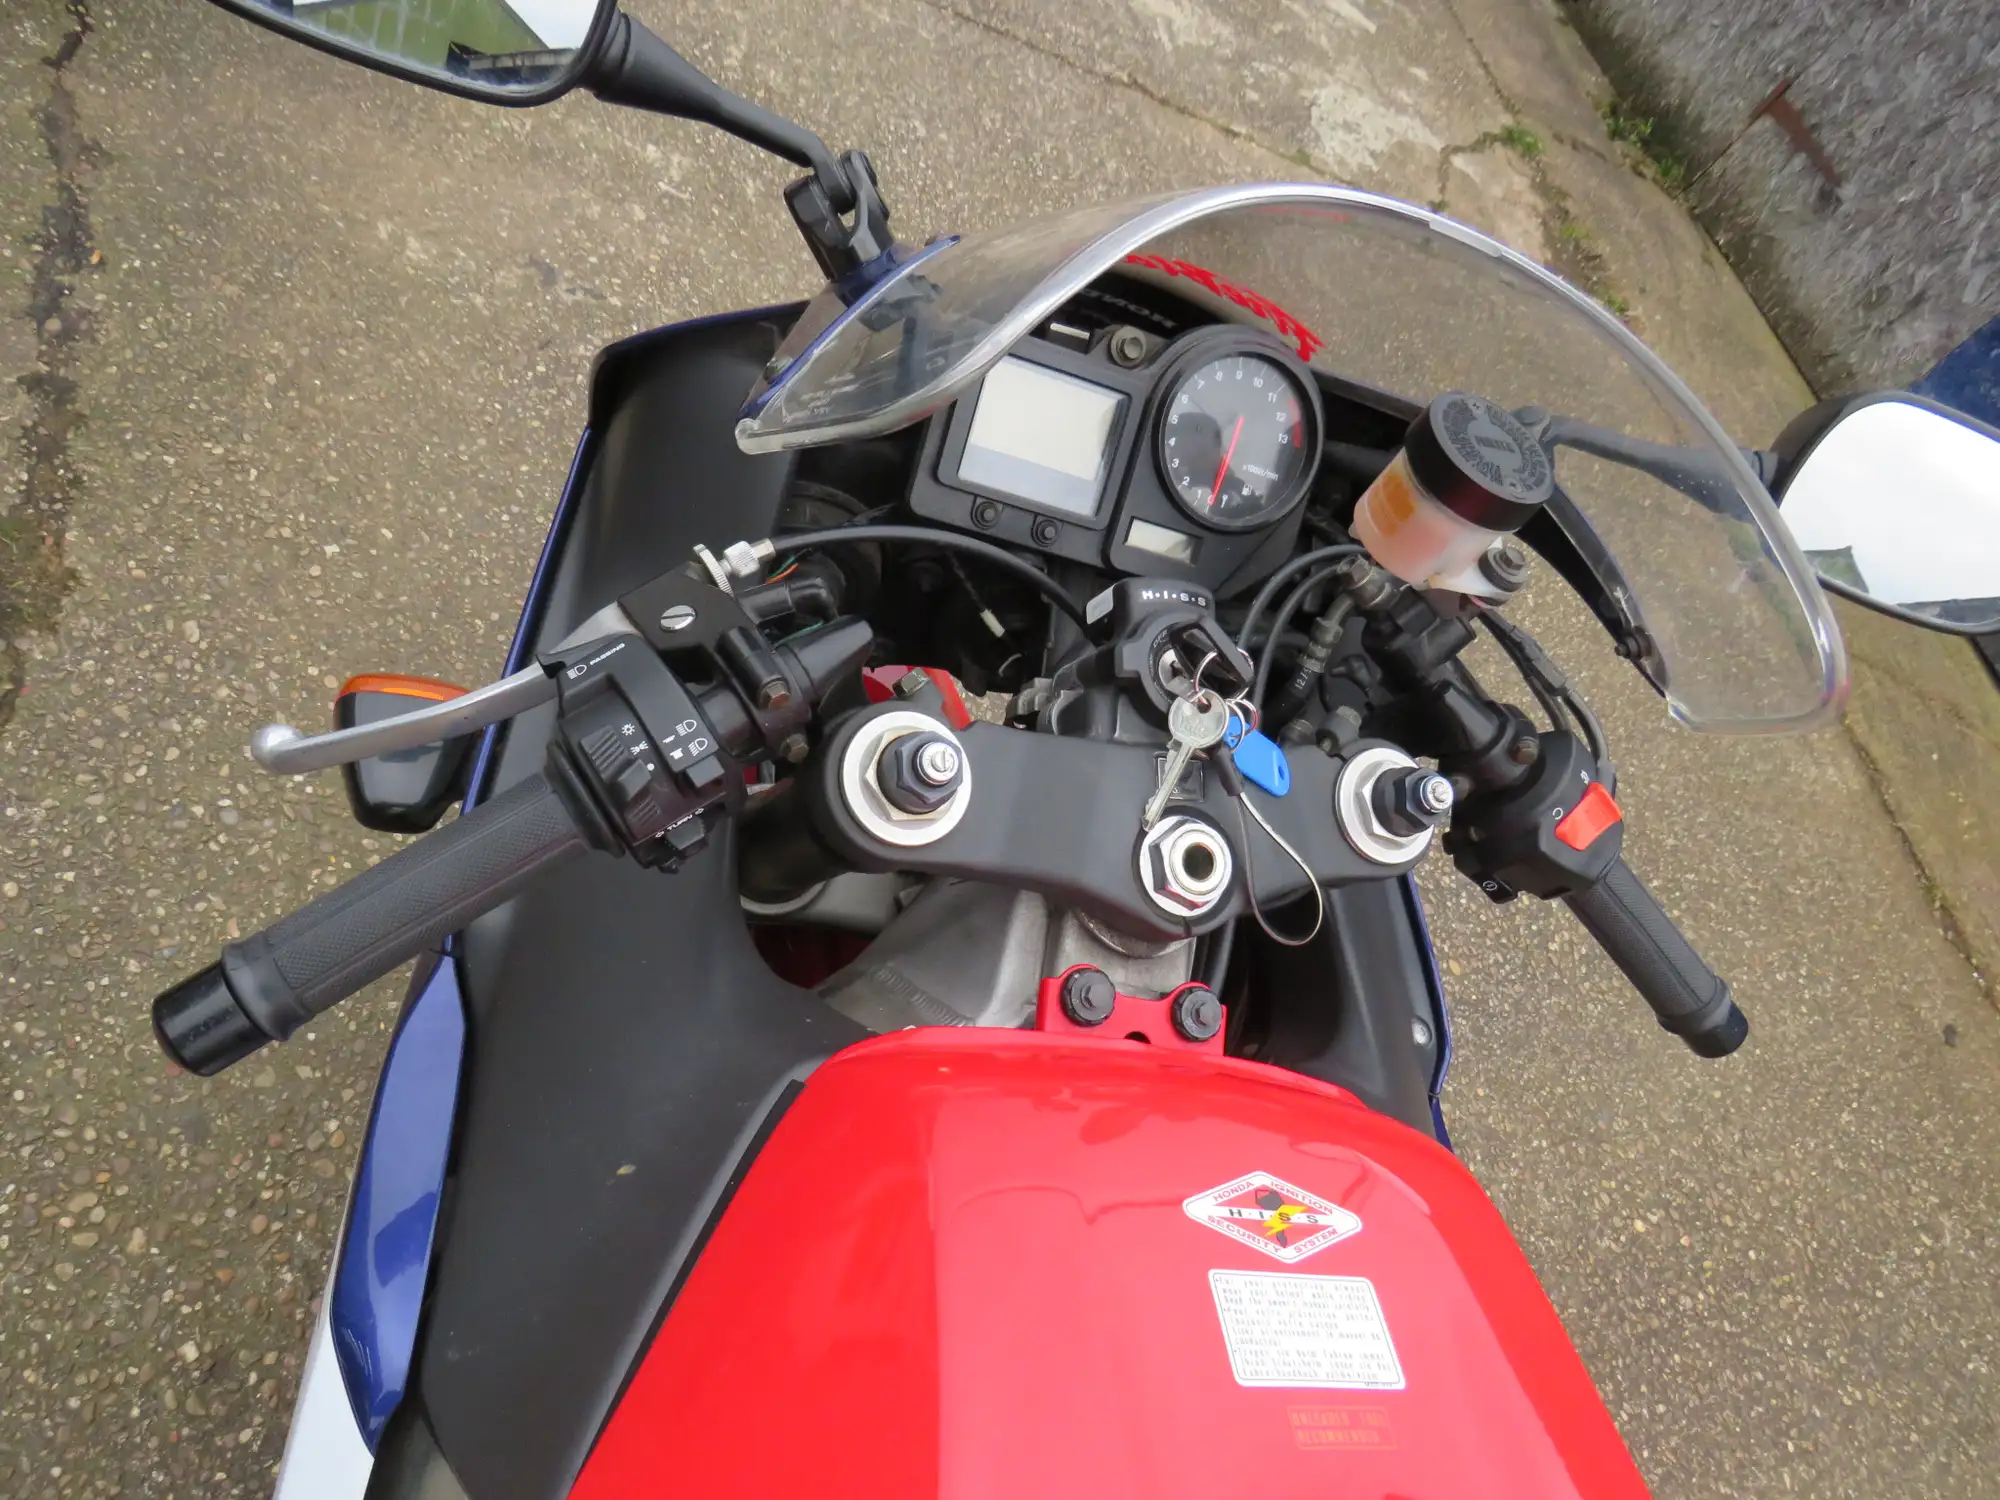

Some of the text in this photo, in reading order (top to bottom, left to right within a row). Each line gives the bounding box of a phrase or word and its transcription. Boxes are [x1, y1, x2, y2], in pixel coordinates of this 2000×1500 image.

[1215, 371, 1223, 381] 8
[1236, 370, 1243, 380] 9
[1197, 380, 1205, 390] 7
[1253, 376, 1264, 388] 10
[1181, 394, 1189, 404] 6
[1268, 392, 1277, 403] 11
[1171, 415, 1178, 425] 5
[1276, 412, 1287, 422] 12
[1168, 437, 1176, 447] 4
[1278, 433, 1288, 444] 13
[1172, 458, 1179, 468] 3
[1181, 476, 1190, 486] 2
[589, 643, 626, 666] PASSING
[666, 813, 693, 832] TURN
[1212, 1180, 1334, 1215] HONDA IGNITION
[1207, 1215, 1338, 1253] SECURITY SYSTEM
